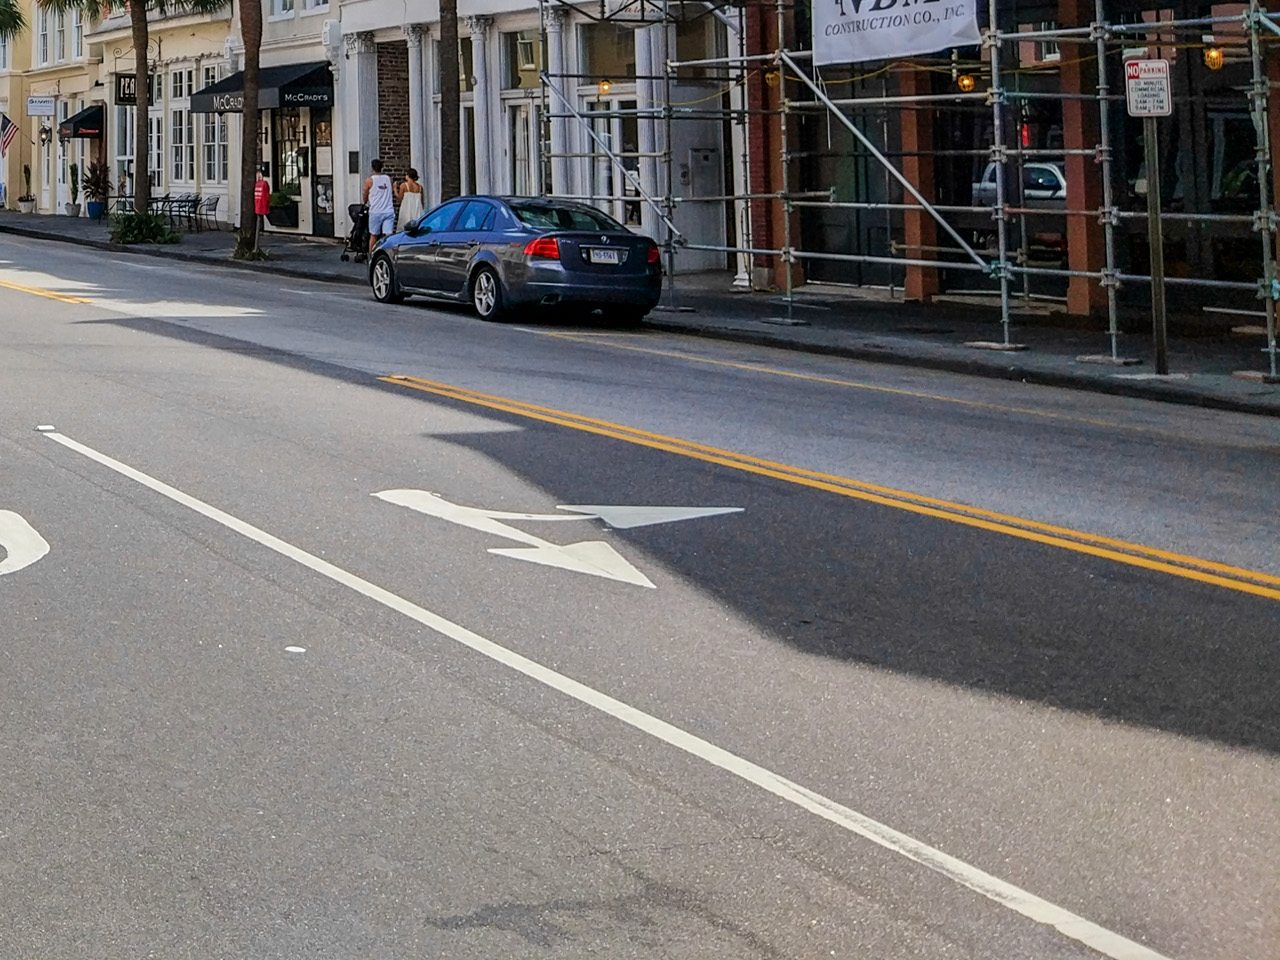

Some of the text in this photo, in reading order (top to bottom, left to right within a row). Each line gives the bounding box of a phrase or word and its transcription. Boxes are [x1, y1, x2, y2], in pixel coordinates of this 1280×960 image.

[825, 4, 965, 37] CONSTRUCTION CO., INC.
[1127, 65, 1139, 76] NO
